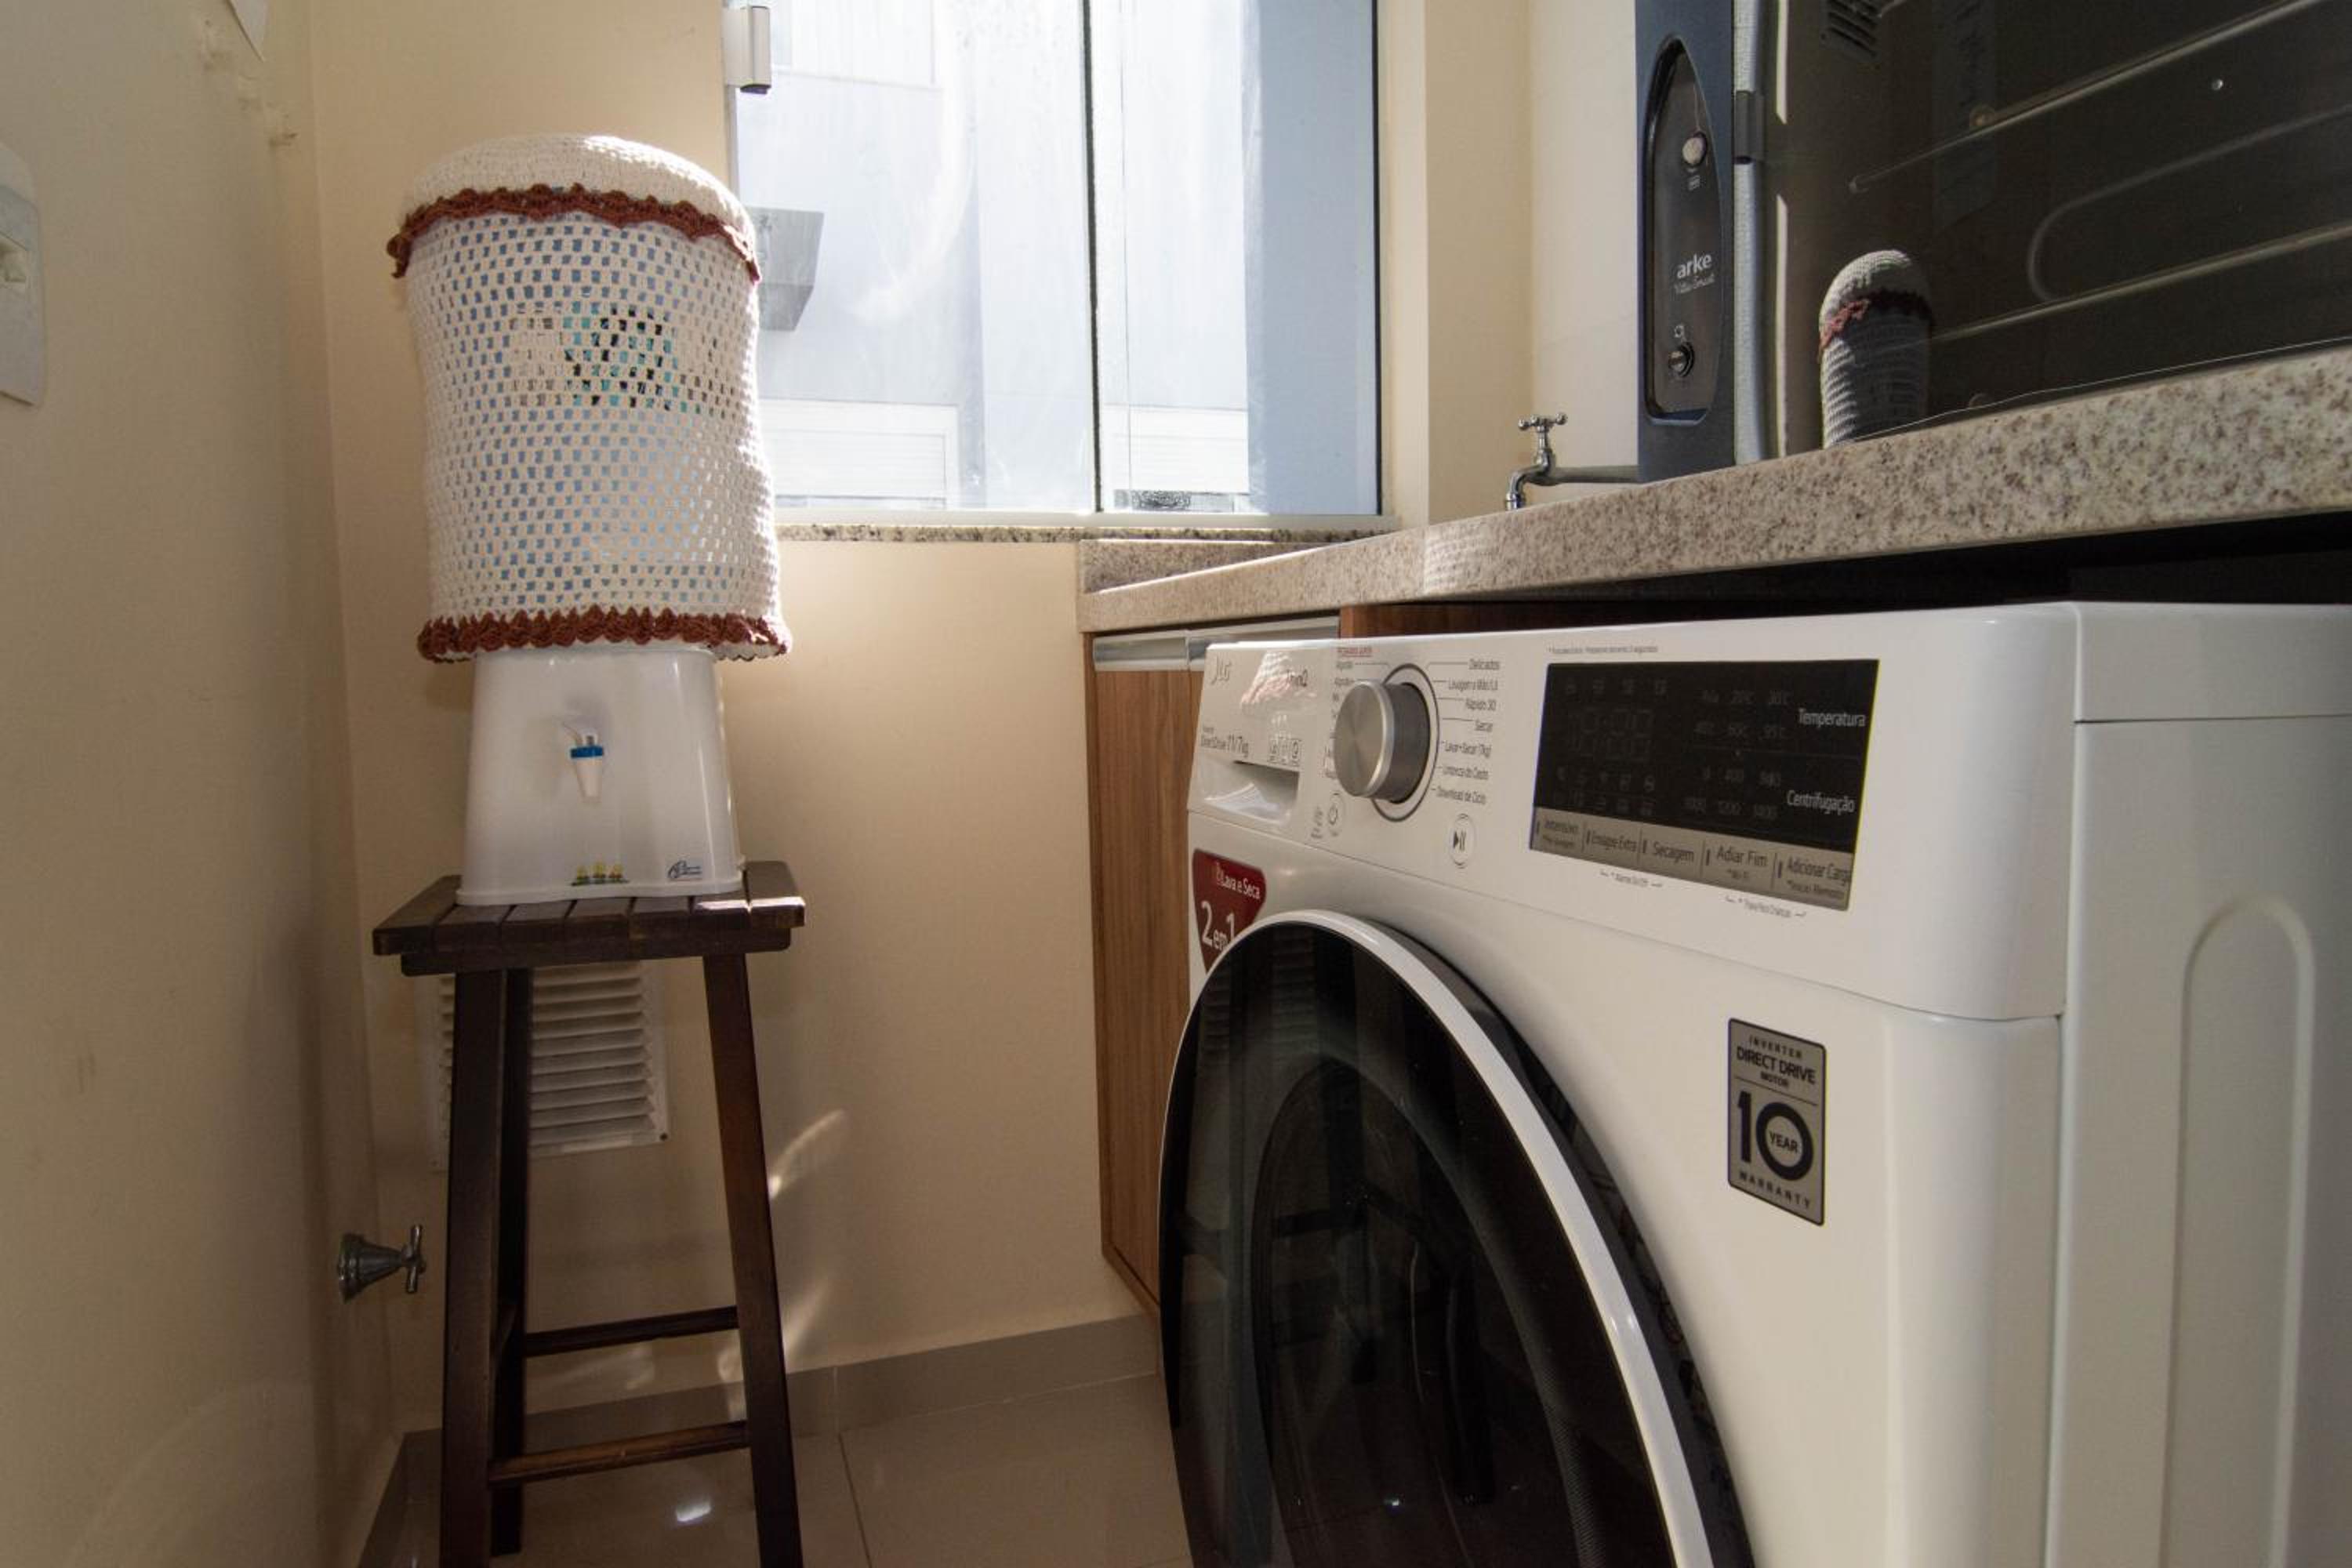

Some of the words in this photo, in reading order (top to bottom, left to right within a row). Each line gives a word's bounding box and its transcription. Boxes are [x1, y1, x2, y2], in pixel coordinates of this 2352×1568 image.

[1677, 253, 1712, 279] arke
[1798, 707, 1866, 728] Temperatura
[1787, 789, 1856, 816] Centrifugação
[1653, 840, 1694, 864] Secagem
[1716, 845, 1744, 865] Adiar
[1747, 850, 1768, 866] Fim
[1237, 880, 1243, 894] e
[1243, 877, 1261, 900] Seca
[1201, 900, 1213, 946] 2
[1226, 912, 1235, 944] 1
[1749, 1035, 1802, 1058] INVERTER
[1736, 1045, 1777, 1072] DIRECT
[1779, 1059, 1817, 1085] DRIVE
[1760, 1071, 1790, 1089] MOTOR
[1737, 1090, 1814, 1181] 10
[1769, 1131, 1799, 1153] YEAR
[1739, 1171, 1811, 1209] WARRANTY
